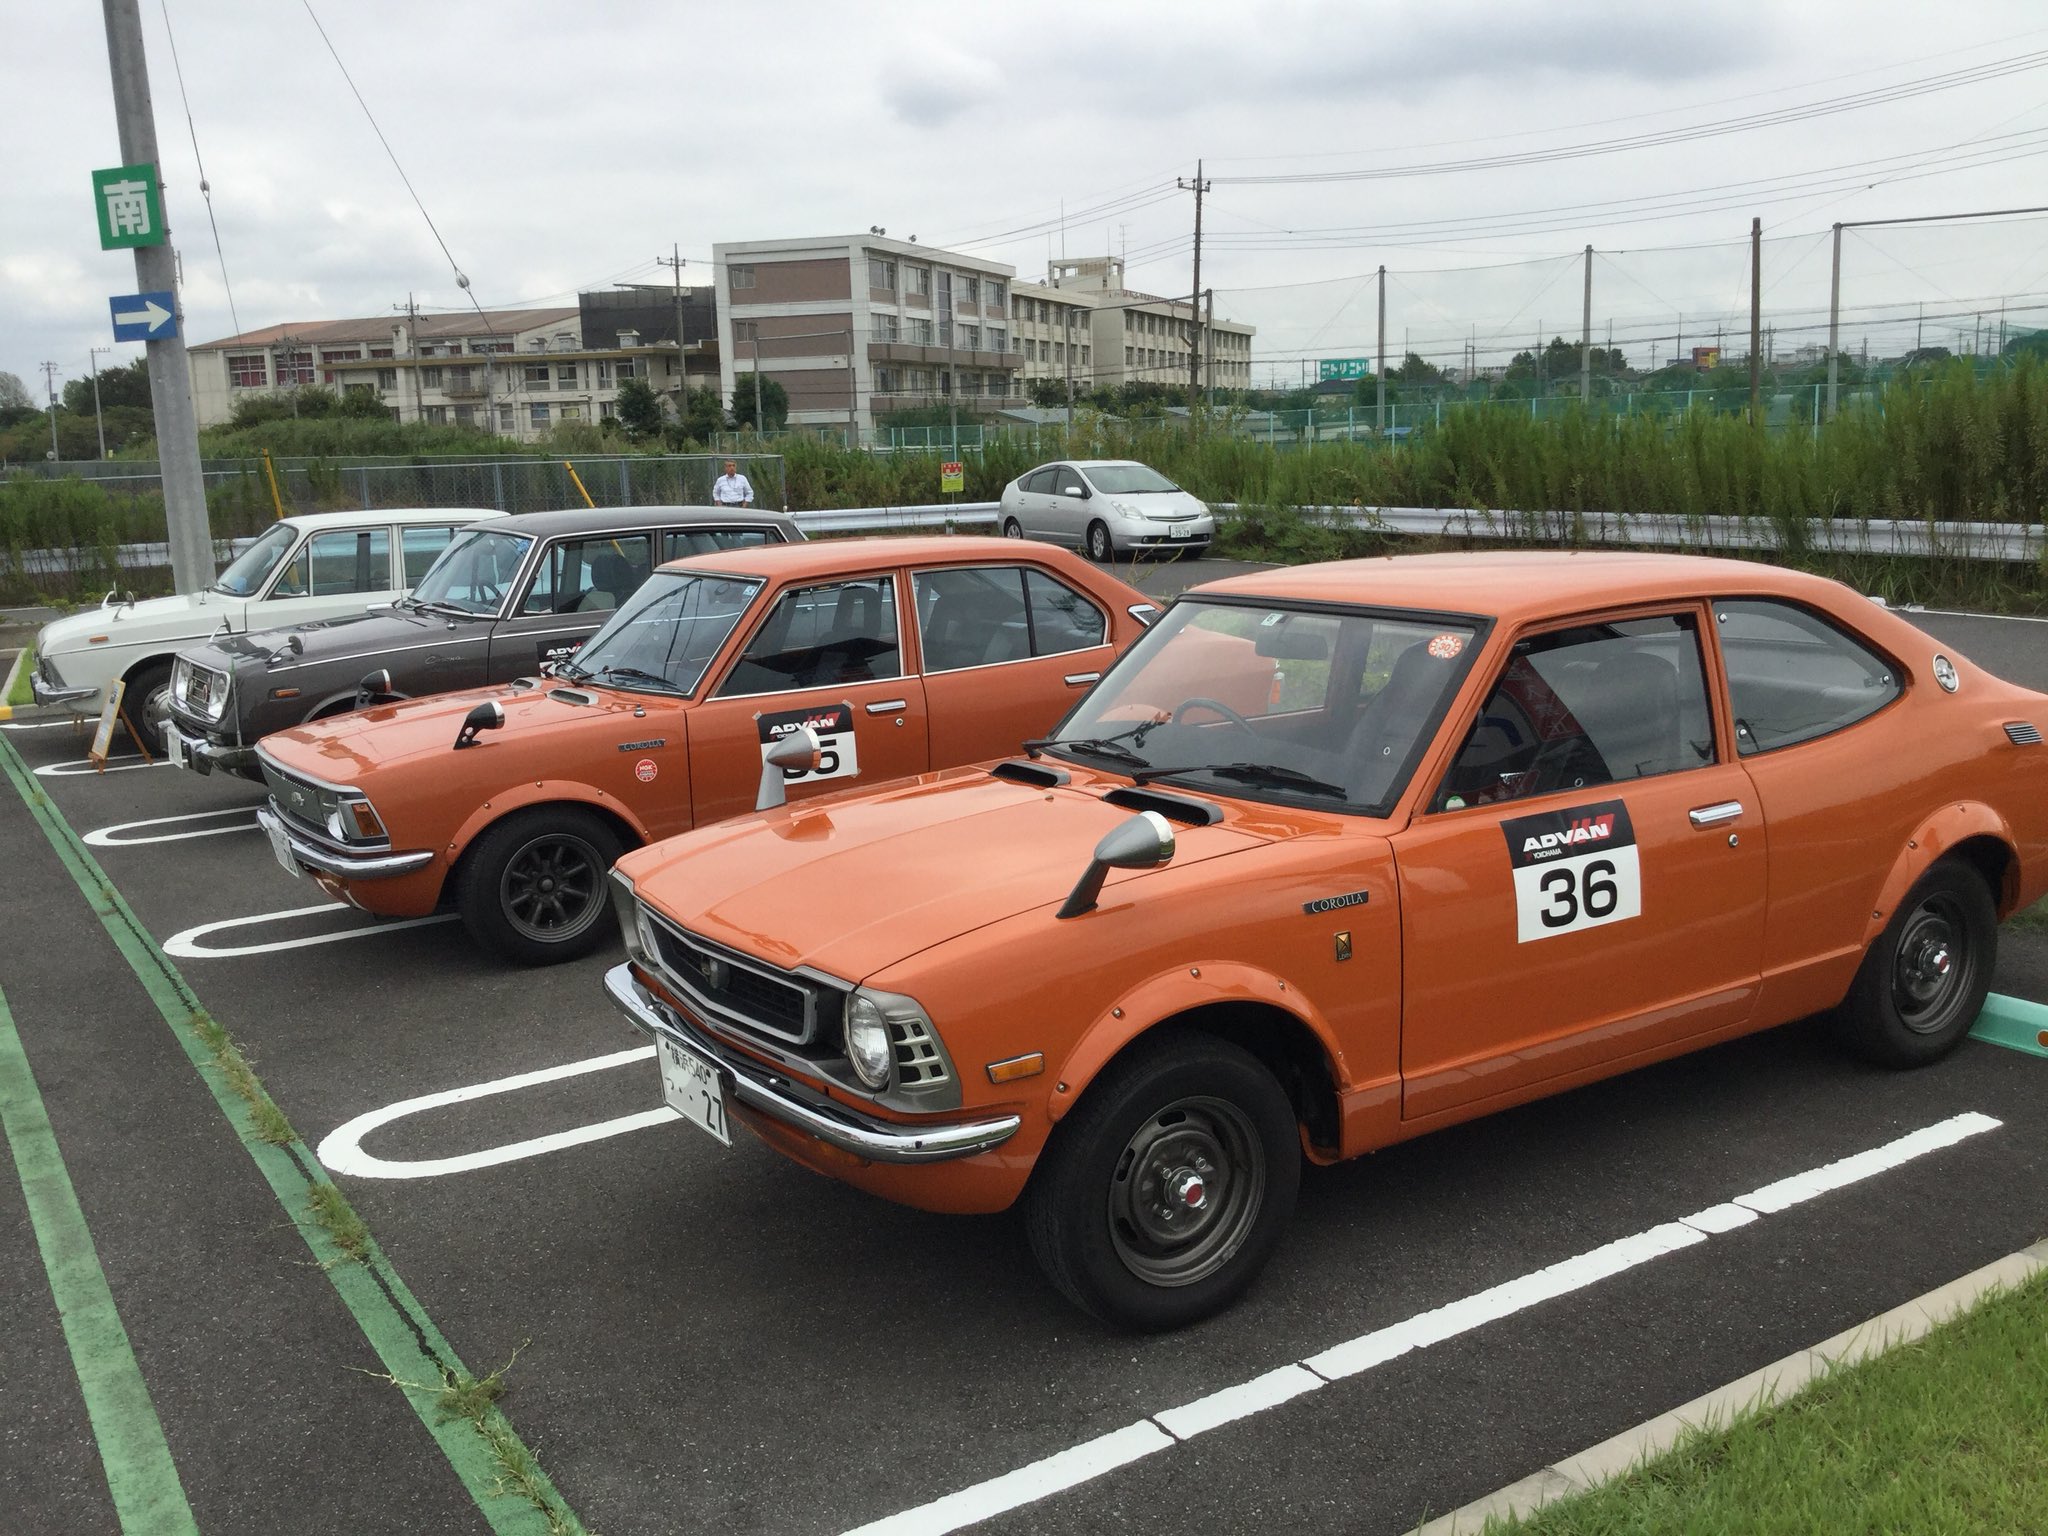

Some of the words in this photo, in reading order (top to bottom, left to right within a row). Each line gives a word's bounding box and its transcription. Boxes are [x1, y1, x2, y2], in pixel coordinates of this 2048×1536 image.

[103, 179, 150, 237] 南
[769, 717, 835, 735] ADVAN
[783, 739, 840, 779] 5
[1523, 823, 1610, 852] ADVAN
[1533, 848, 1562, 860] YOKOHAMA
[1311, 893, 1364, 913] COROLLA
[1540, 859, 1618, 928] 36
[671, 1045, 688, 1071] 横浜
[687, 1057, 708, 1085] 540
[701, 1090, 724, 1136] 27
